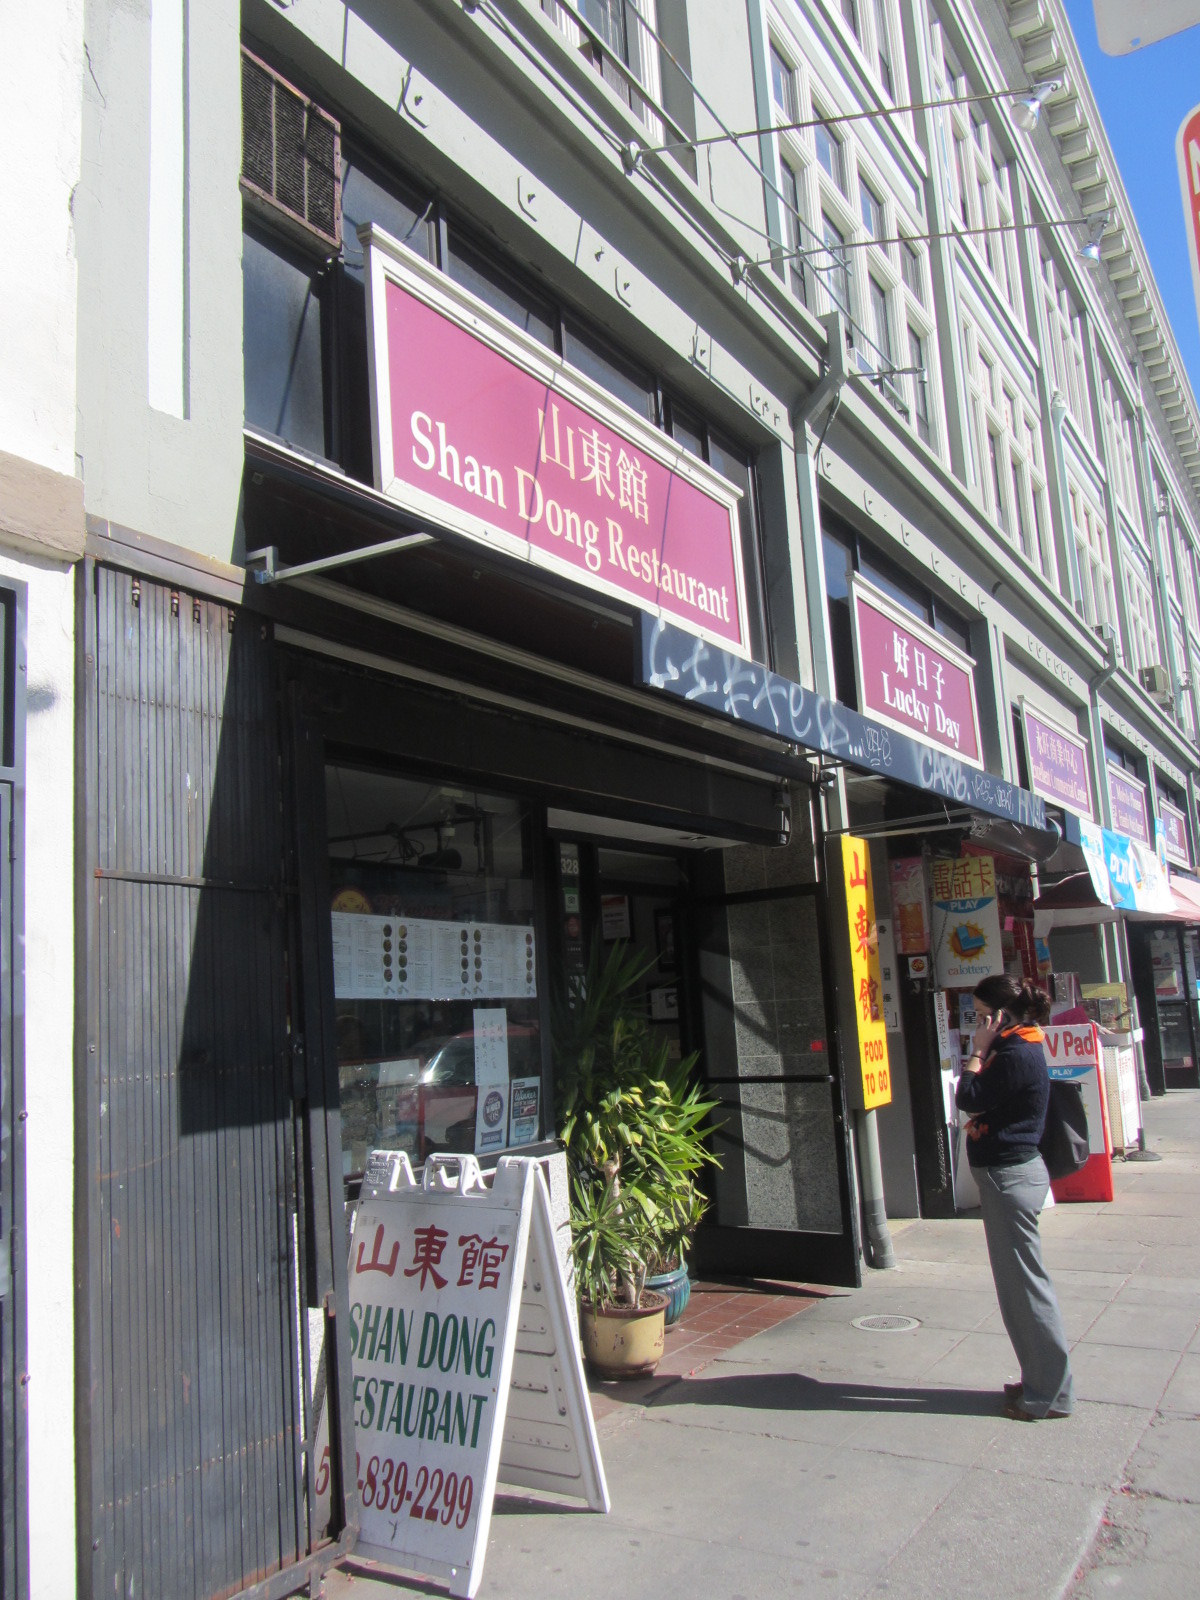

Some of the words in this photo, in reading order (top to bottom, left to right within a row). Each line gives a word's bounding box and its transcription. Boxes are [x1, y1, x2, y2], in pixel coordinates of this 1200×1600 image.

[537, 402, 649, 525] 山東館
[410, 410, 506, 510] Shan
[514, 465, 600, 571] Dong
[605, 517, 730, 623] Restaurant
[893, 631, 946, 701] 好日子
[881, 671, 930, 733] Lucky
[935, 707, 960, 748] Day
[560, 858, 579, 875] 328
[933, 858, 993, 900] 電話卡
[950, 900, 979, 911] PLAY
[849, 850, 879, 1021] 山東館
[948, 964, 993, 976] calottery
[864, 1039, 884, 1064] FOOD
[1063, 1029, 1095, 1057] Pad
[865, 1072, 876, 1095] TO
[878, 1069, 888, 1092] GO
[1052, 1068, 1073, 1077] PLAY
[355, 1224, 509, 1291] 山東館
[349, 1302, 417, 1367] SHAN
[417, 1311, 496, 1379] DONG
[353, 1375, 489, 1450] ESTAURANT
